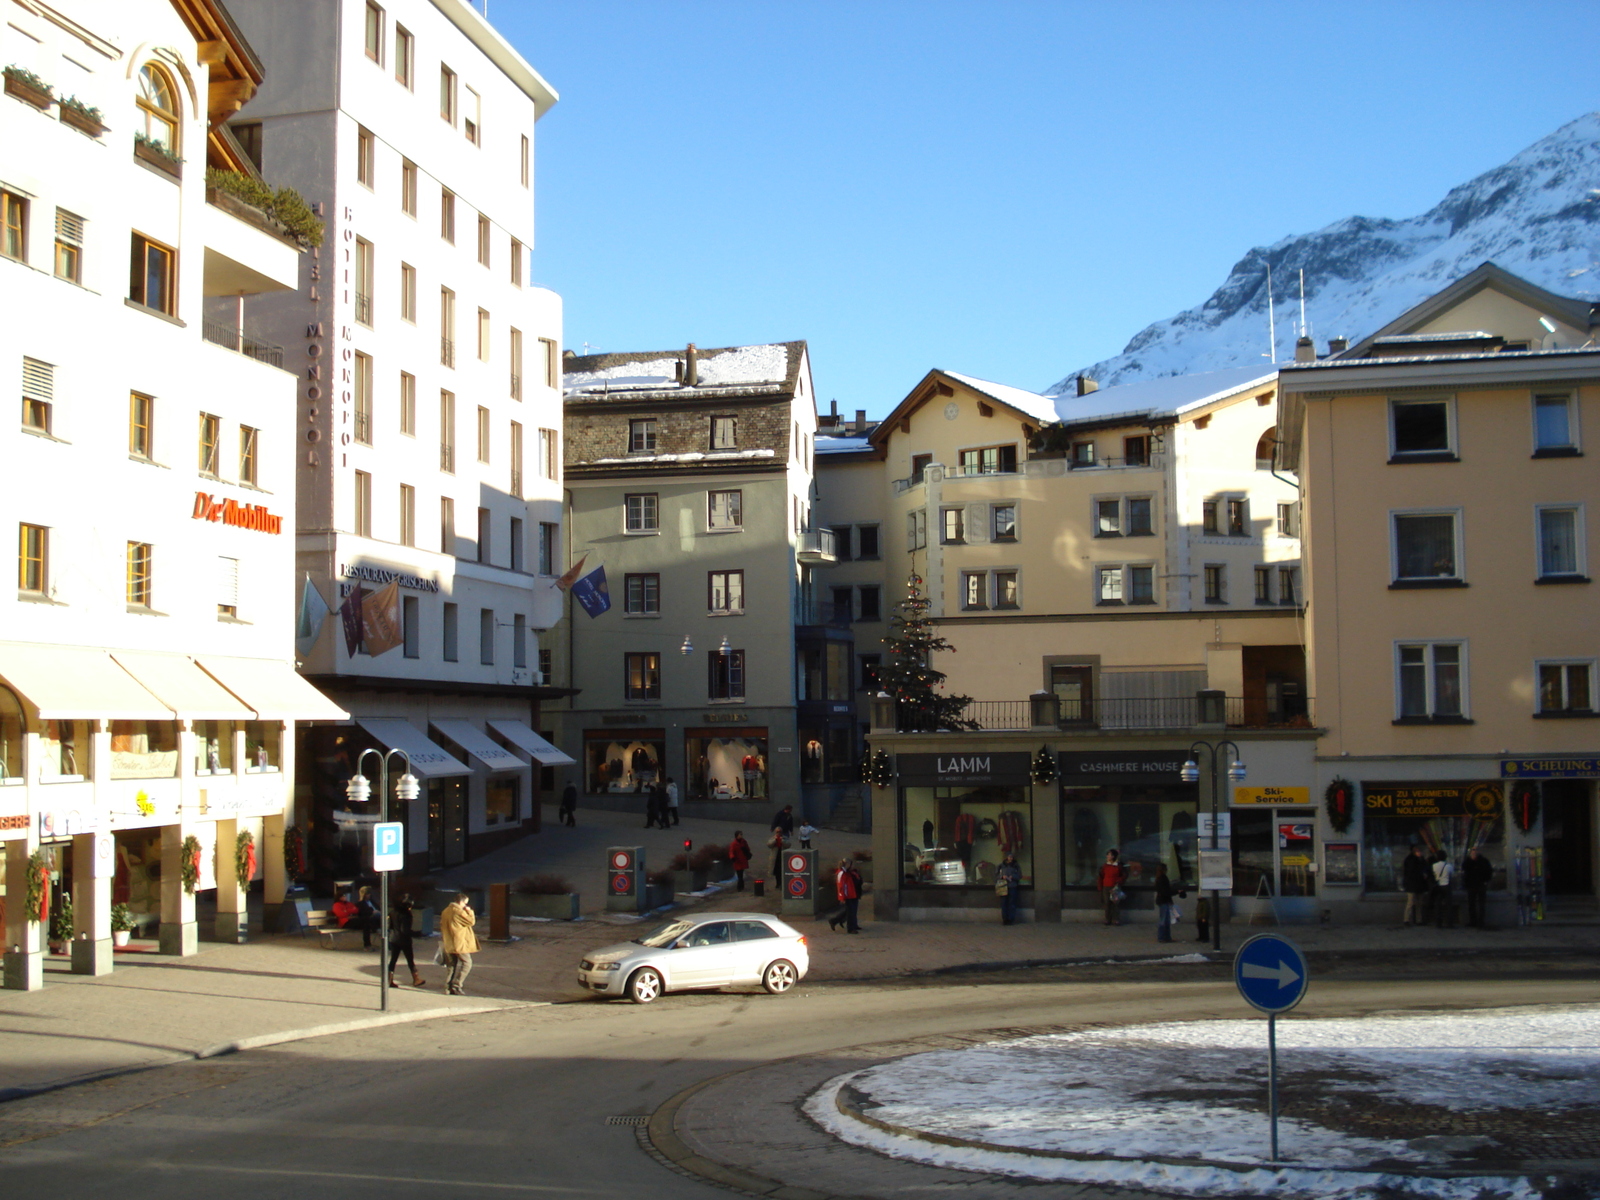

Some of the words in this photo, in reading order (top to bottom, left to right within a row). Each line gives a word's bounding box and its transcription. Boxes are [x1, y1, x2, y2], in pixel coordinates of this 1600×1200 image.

[304, 321, 323, 467] MONOPOL
[191, 491, 222, 523] Die
[222, 497, 283, 535] Mobiliar
[937, 756, 991, 774] LAMM
[1080, 762, 1138, 773] CASHMERE
[1142, 762, 1178, 772] HOUSE
[1522, 760, 1592, 771] SCHEUING
[1264, 787, 1284, 796] Ski-
[1396, 790, 1408, 798] ZU
[1411, 789, 1458, 798] VERMIETEN
[1255, 795, 1294, 803] Service
[1366, 794, 1392, 809] SKI
[1396, 798, 1413, 806] FOR
[1415, 798, 1435, 806] HIRE
[1396, 806, 1440, 815] NOLEGGIO
[382, 829, 397, 854] P
